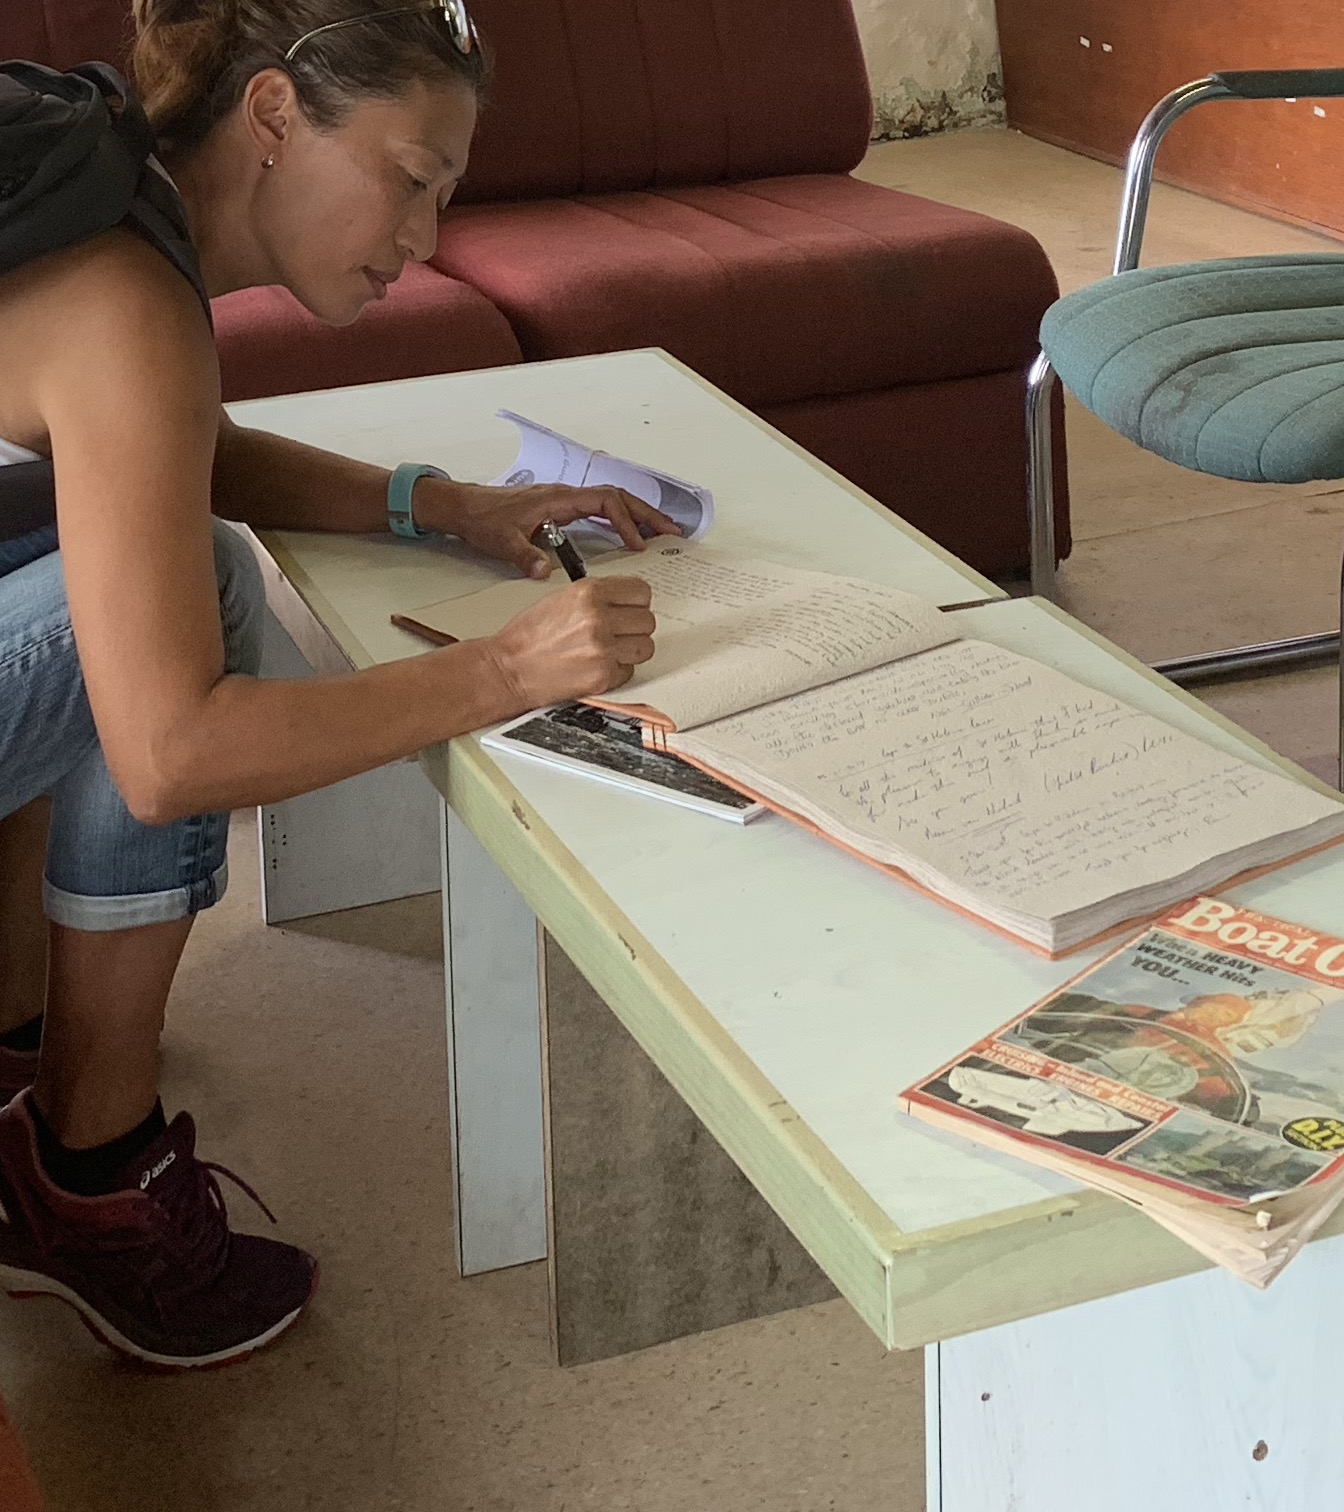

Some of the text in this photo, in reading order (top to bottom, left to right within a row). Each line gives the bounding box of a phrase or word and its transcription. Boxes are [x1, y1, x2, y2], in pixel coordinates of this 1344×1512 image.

[1168, 896, 1320, 967] Boat
[1138, 943, 1255, 987] WEATHER Hits
[1203, 952, 1264, 975] HEAVY
[991, 1042, 1045, 1065] CRUISING
[151, 1149, 176, 1178] asics
